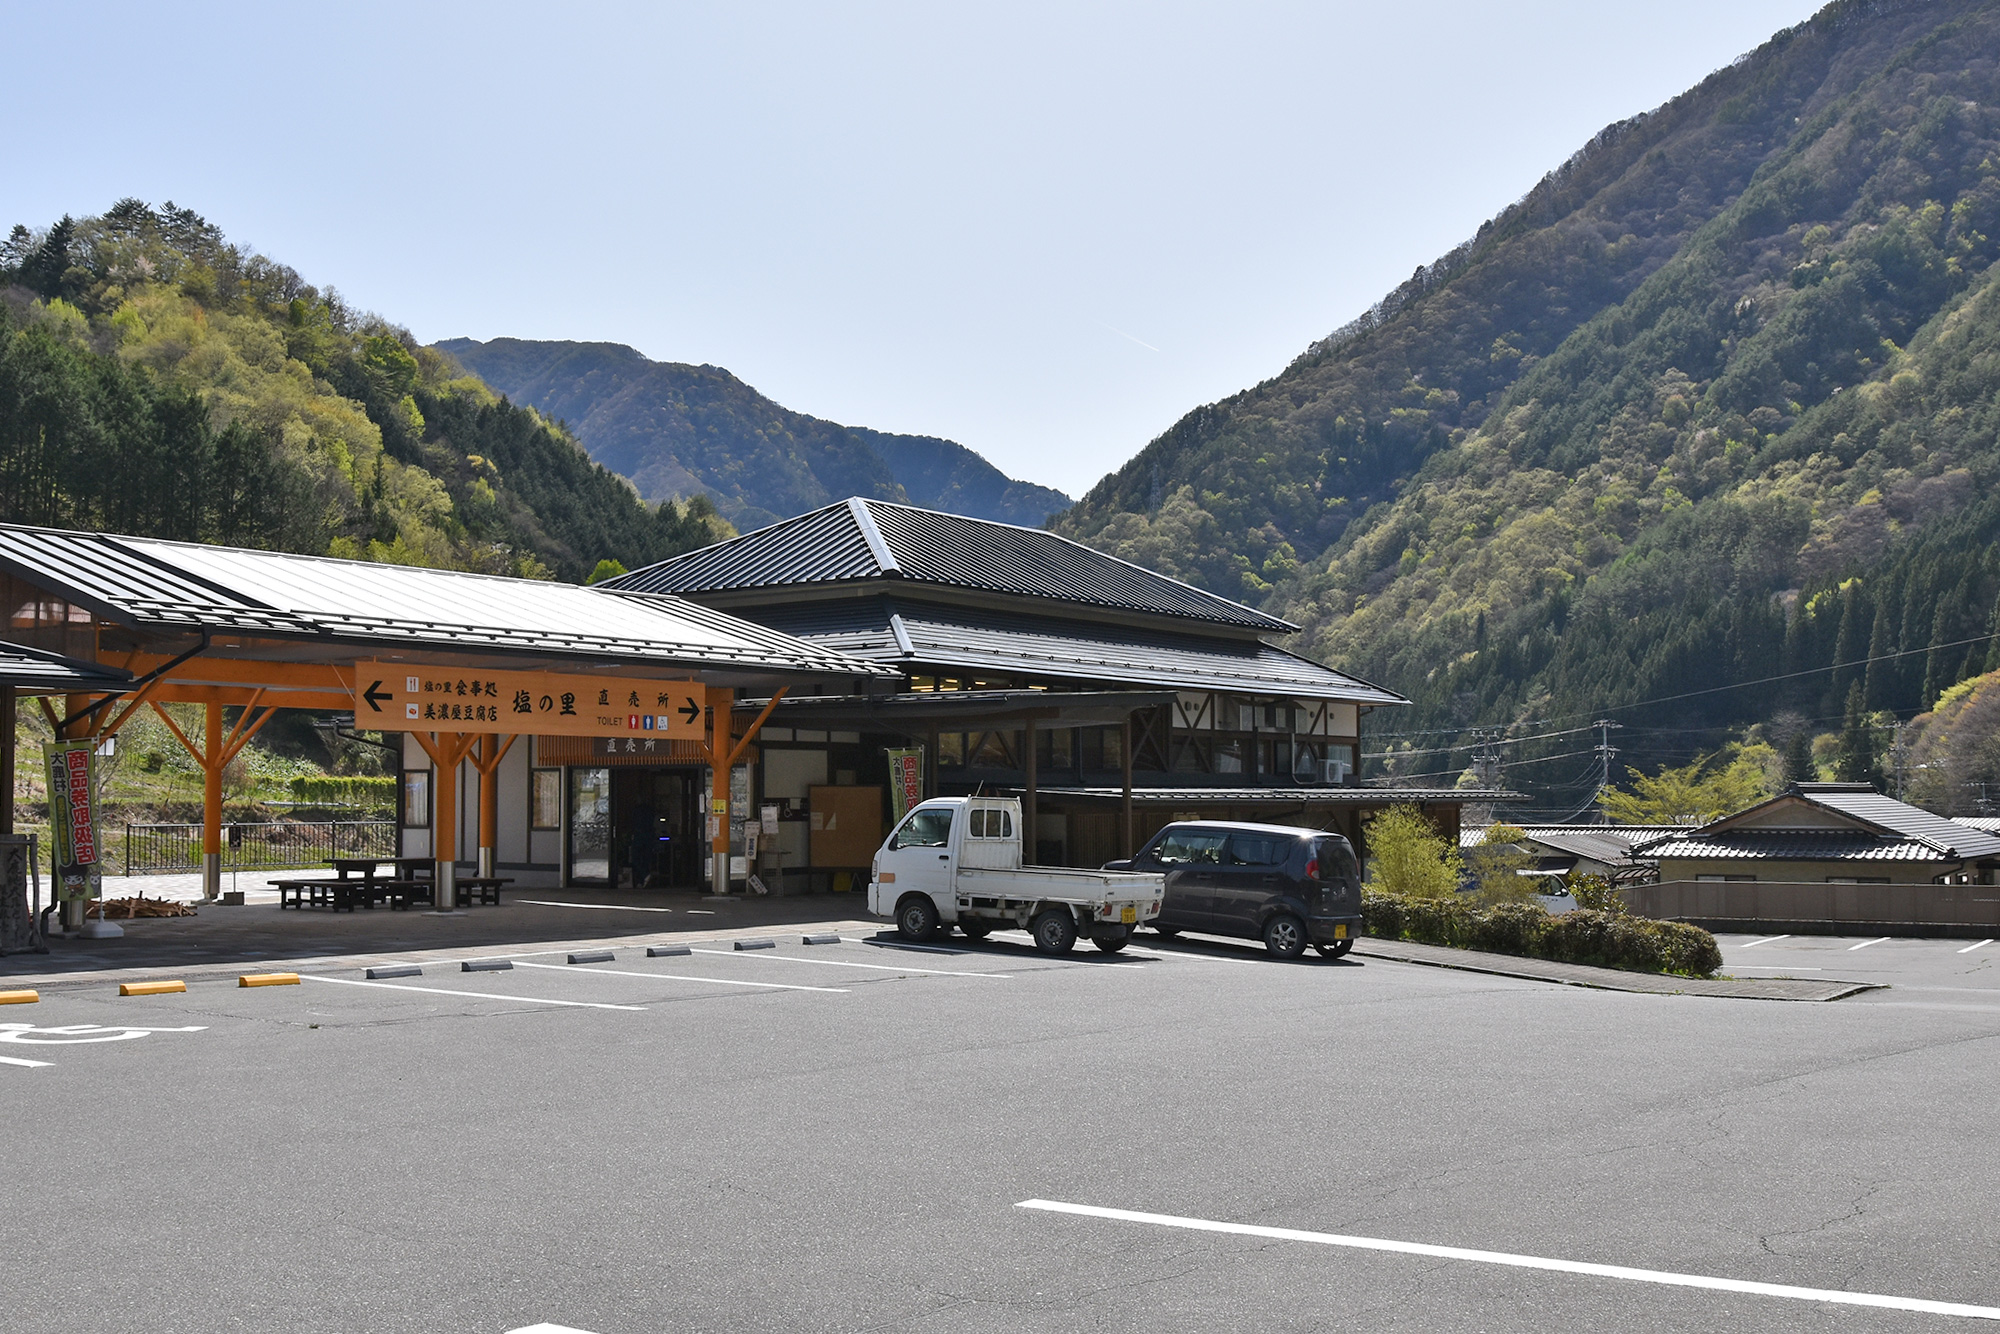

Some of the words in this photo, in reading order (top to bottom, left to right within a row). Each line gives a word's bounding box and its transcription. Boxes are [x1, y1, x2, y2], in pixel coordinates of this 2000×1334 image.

[513, 690, 577, 716] 塩の里
[598, 689, 669, 709] 直売所
[424, 702, 498, 722] 美濃屋豆腐店
[597, 716, 623, 726] TOILET
[607, 737, 655, 753] 直売所
